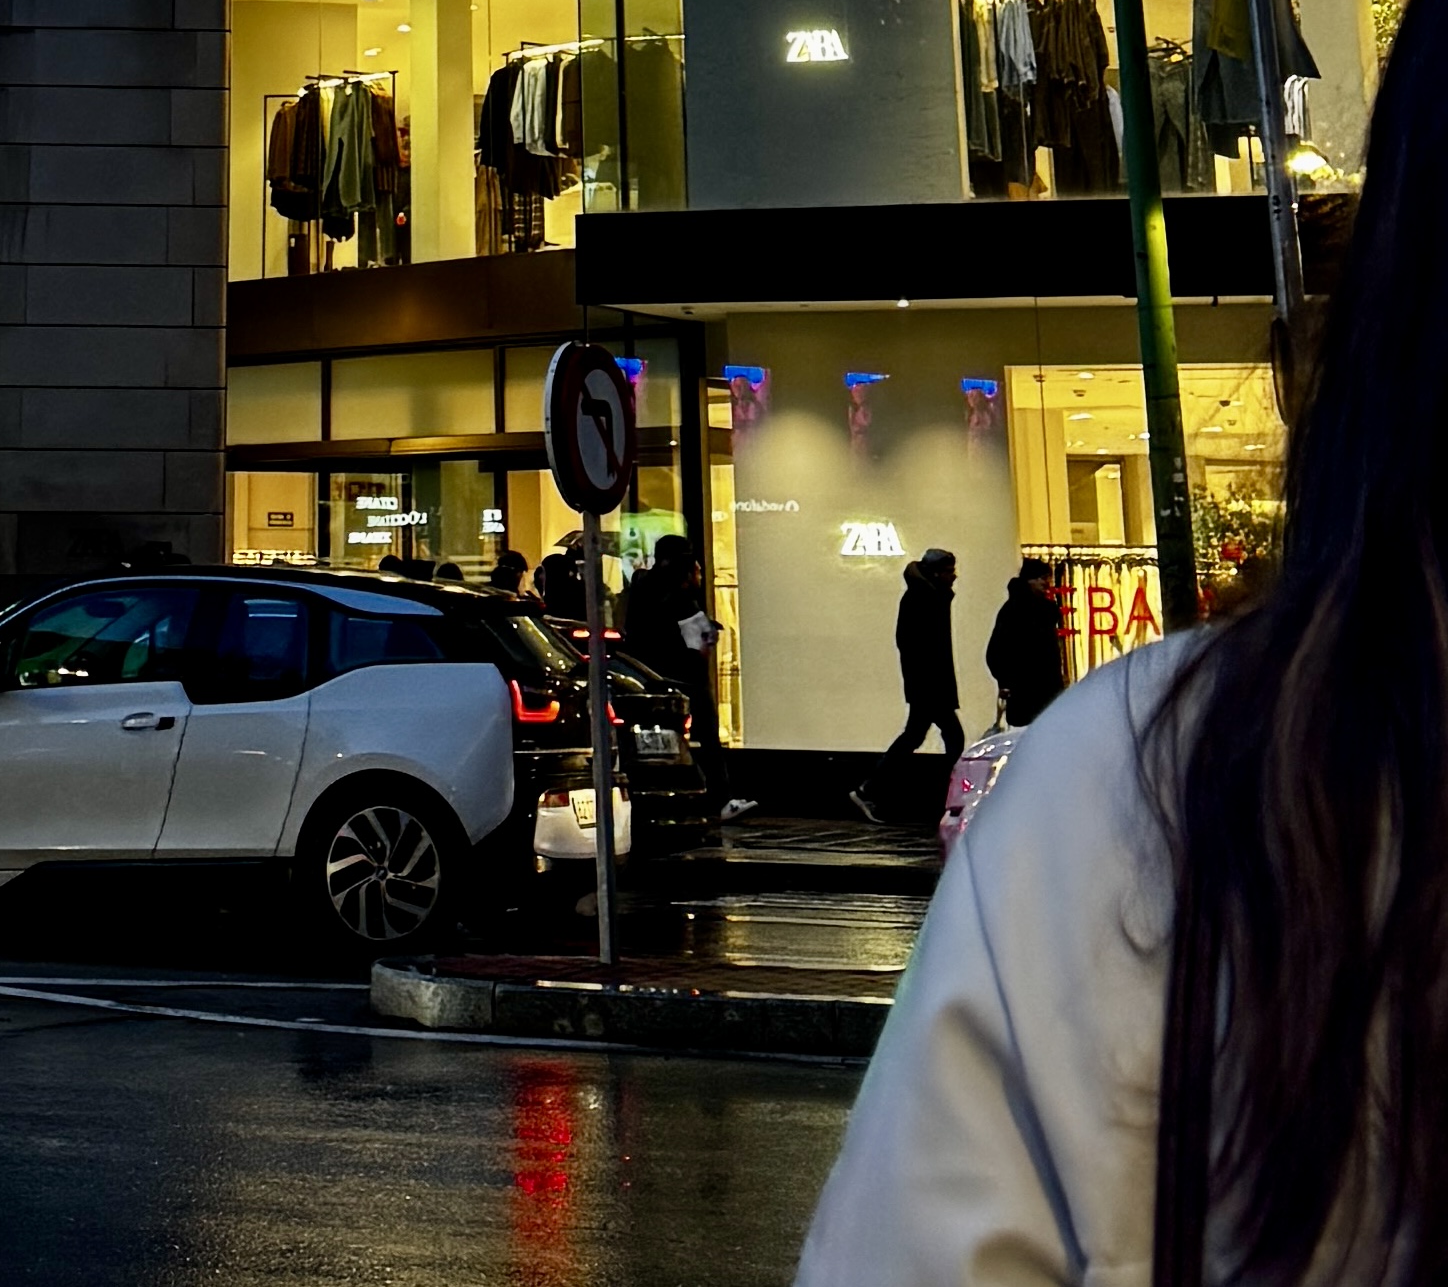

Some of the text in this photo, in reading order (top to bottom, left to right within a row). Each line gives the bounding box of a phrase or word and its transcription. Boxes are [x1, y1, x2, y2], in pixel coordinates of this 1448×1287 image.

[786, 28, 849, 63] ZARA
[840, 521, 906, 556] ZARA
[1048, 585, 1162, 637] EBA
